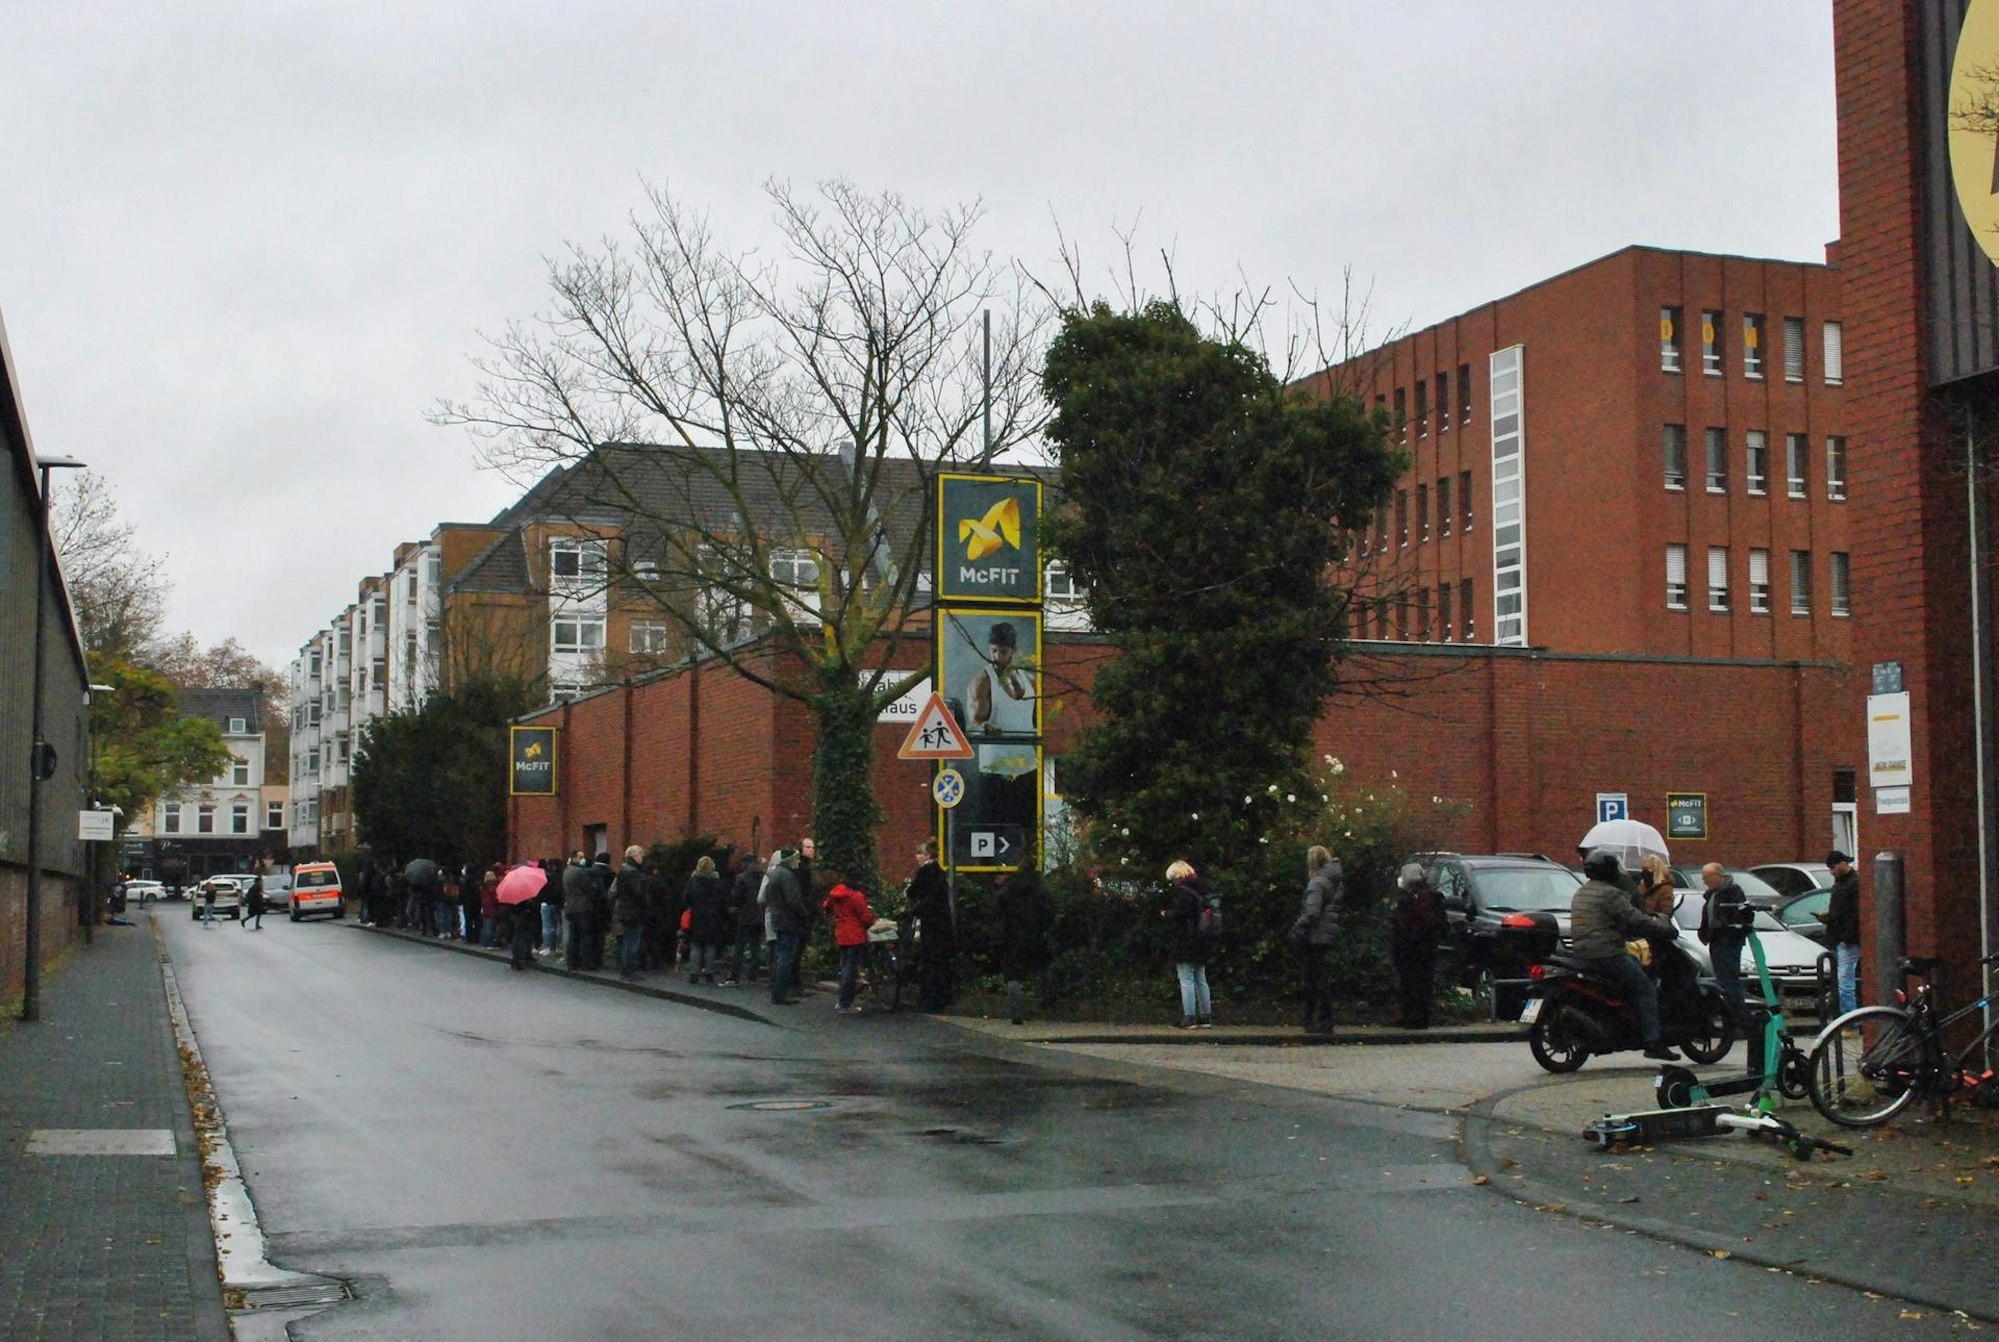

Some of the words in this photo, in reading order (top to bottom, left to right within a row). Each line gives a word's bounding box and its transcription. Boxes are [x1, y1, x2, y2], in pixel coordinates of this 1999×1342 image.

[960, 566, 1019, 585] McFIT
[516, 761, 550, 771] McFIT
[1678, 800, 1702, 808] McFIT
[1605, 802, 1618, 821] P
[978, 839, 988, 851] P
